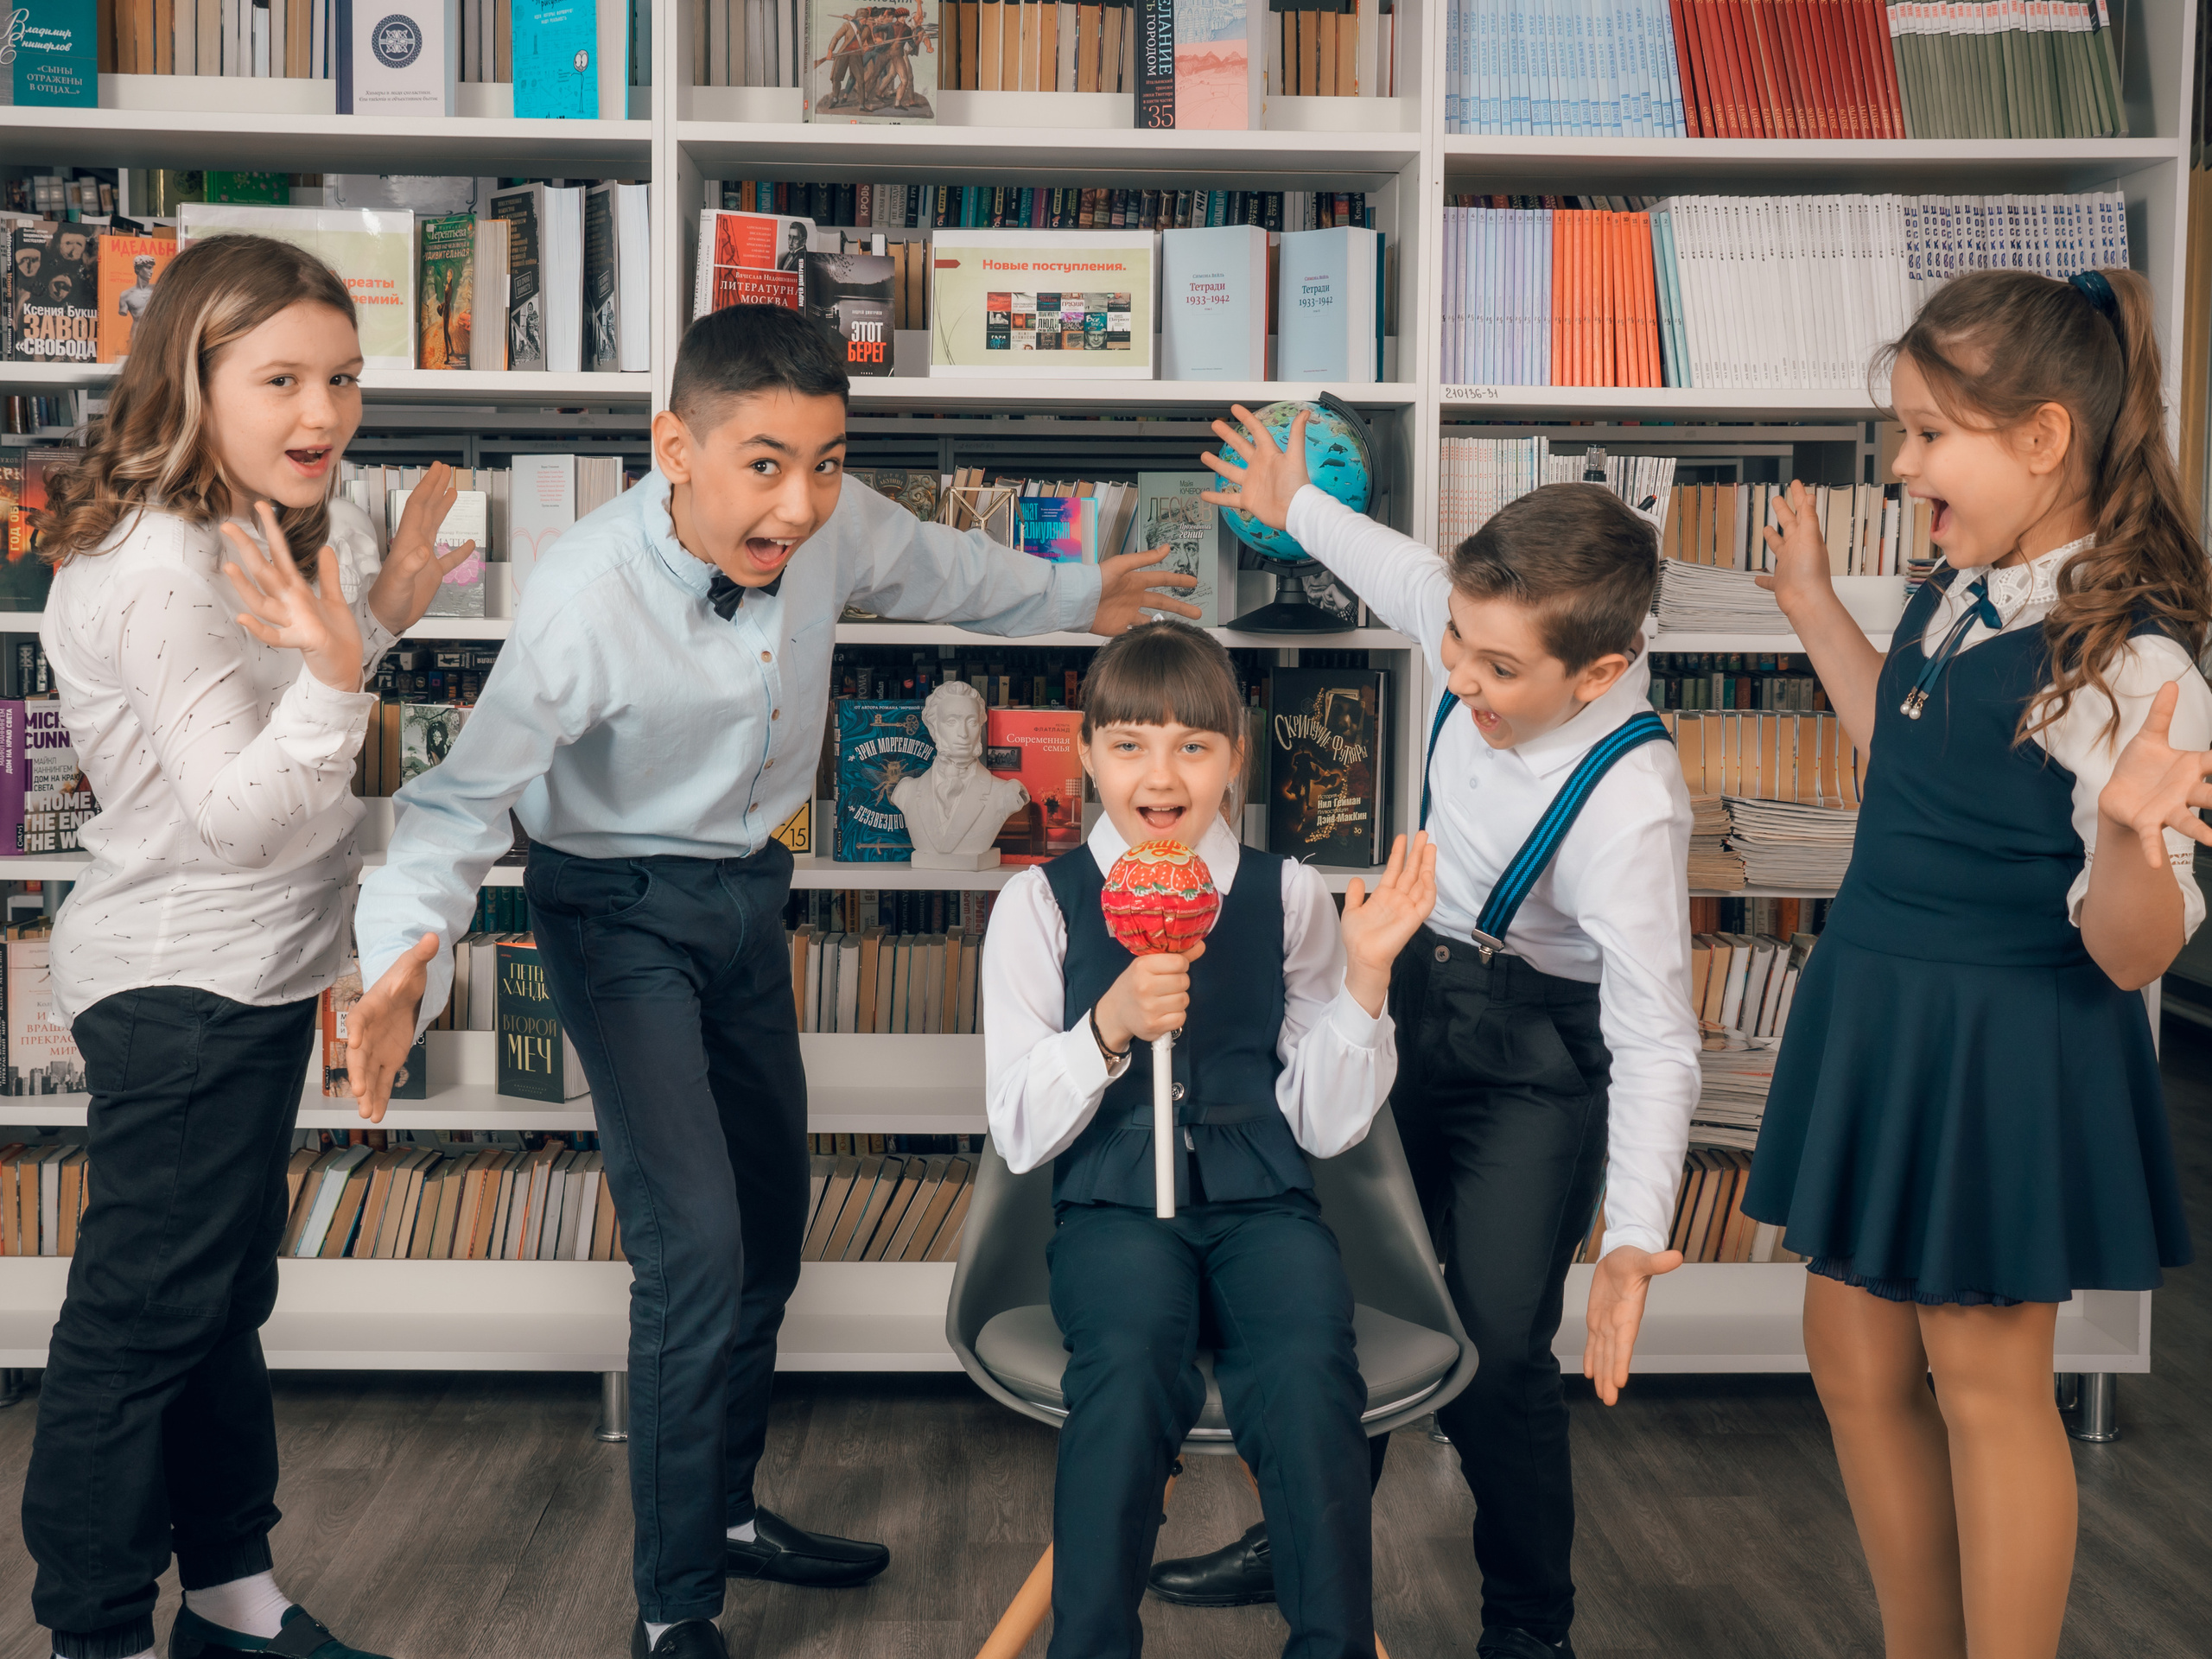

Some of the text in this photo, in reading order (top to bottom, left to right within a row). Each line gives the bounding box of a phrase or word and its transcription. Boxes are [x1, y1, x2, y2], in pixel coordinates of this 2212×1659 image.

[0, 8, 73, 41] Владимир
[1146, 14, 1157, 76] ГОРОДОМ
[37, 65, 73, 75] «СЫНЫ
[27, 73, 83, 86] ОТРАЖЕНЫ
[1148, 105, 1174, 128] 35
[861, 185, 869, 216] КРОВЬ
[111, 239, 176, 257] ИДЕАЛЬН
[982, 259, 1127, 273] Новые поступления.
[735, 271, 763, 280] Вячеслав
[1190, 282, 1225, 294] Тетради
[1302, 283, 1330, 295] Тетради
[741, 294, 788, 308] МОСКВА
[23, 303, 64, 316] Ксения
[851, 321, 883, 342] ЭТОТ
[16, 338, 97, 360] «СВОБОДА
[848, 341, 887, 362] БЕРЕГ
[1147, 496, 1213, 523] ЛЕСКОВ
[10, 526, 19, 551] ГОД
[1179, 530, 1204, 539] гений
[434, 537, 481, 549] МАТИС
[1007, 734, 1071, 746] Современная
[6, 750, 13, 760] НА
[855, 739, 879, 761] ЭРИН
[34, 757, 56, 766] МАЙКЛ
[34, 775, 49, 784] ДОМ
[62, 772, 80, 781] КРАЮ
[40, 791, 91, 811] HOME
[1318, 797, 1361, 809] Нил Гейман
[1317, 814, 1336, 826] Дэйв
[790, 828, 806, 847] 15
[503, 1014, 556, 1037] ВТОРОЙ
[49, 1046, 77, 1056] МИР
[508, 1033, 551, 1074] МЕЧ
